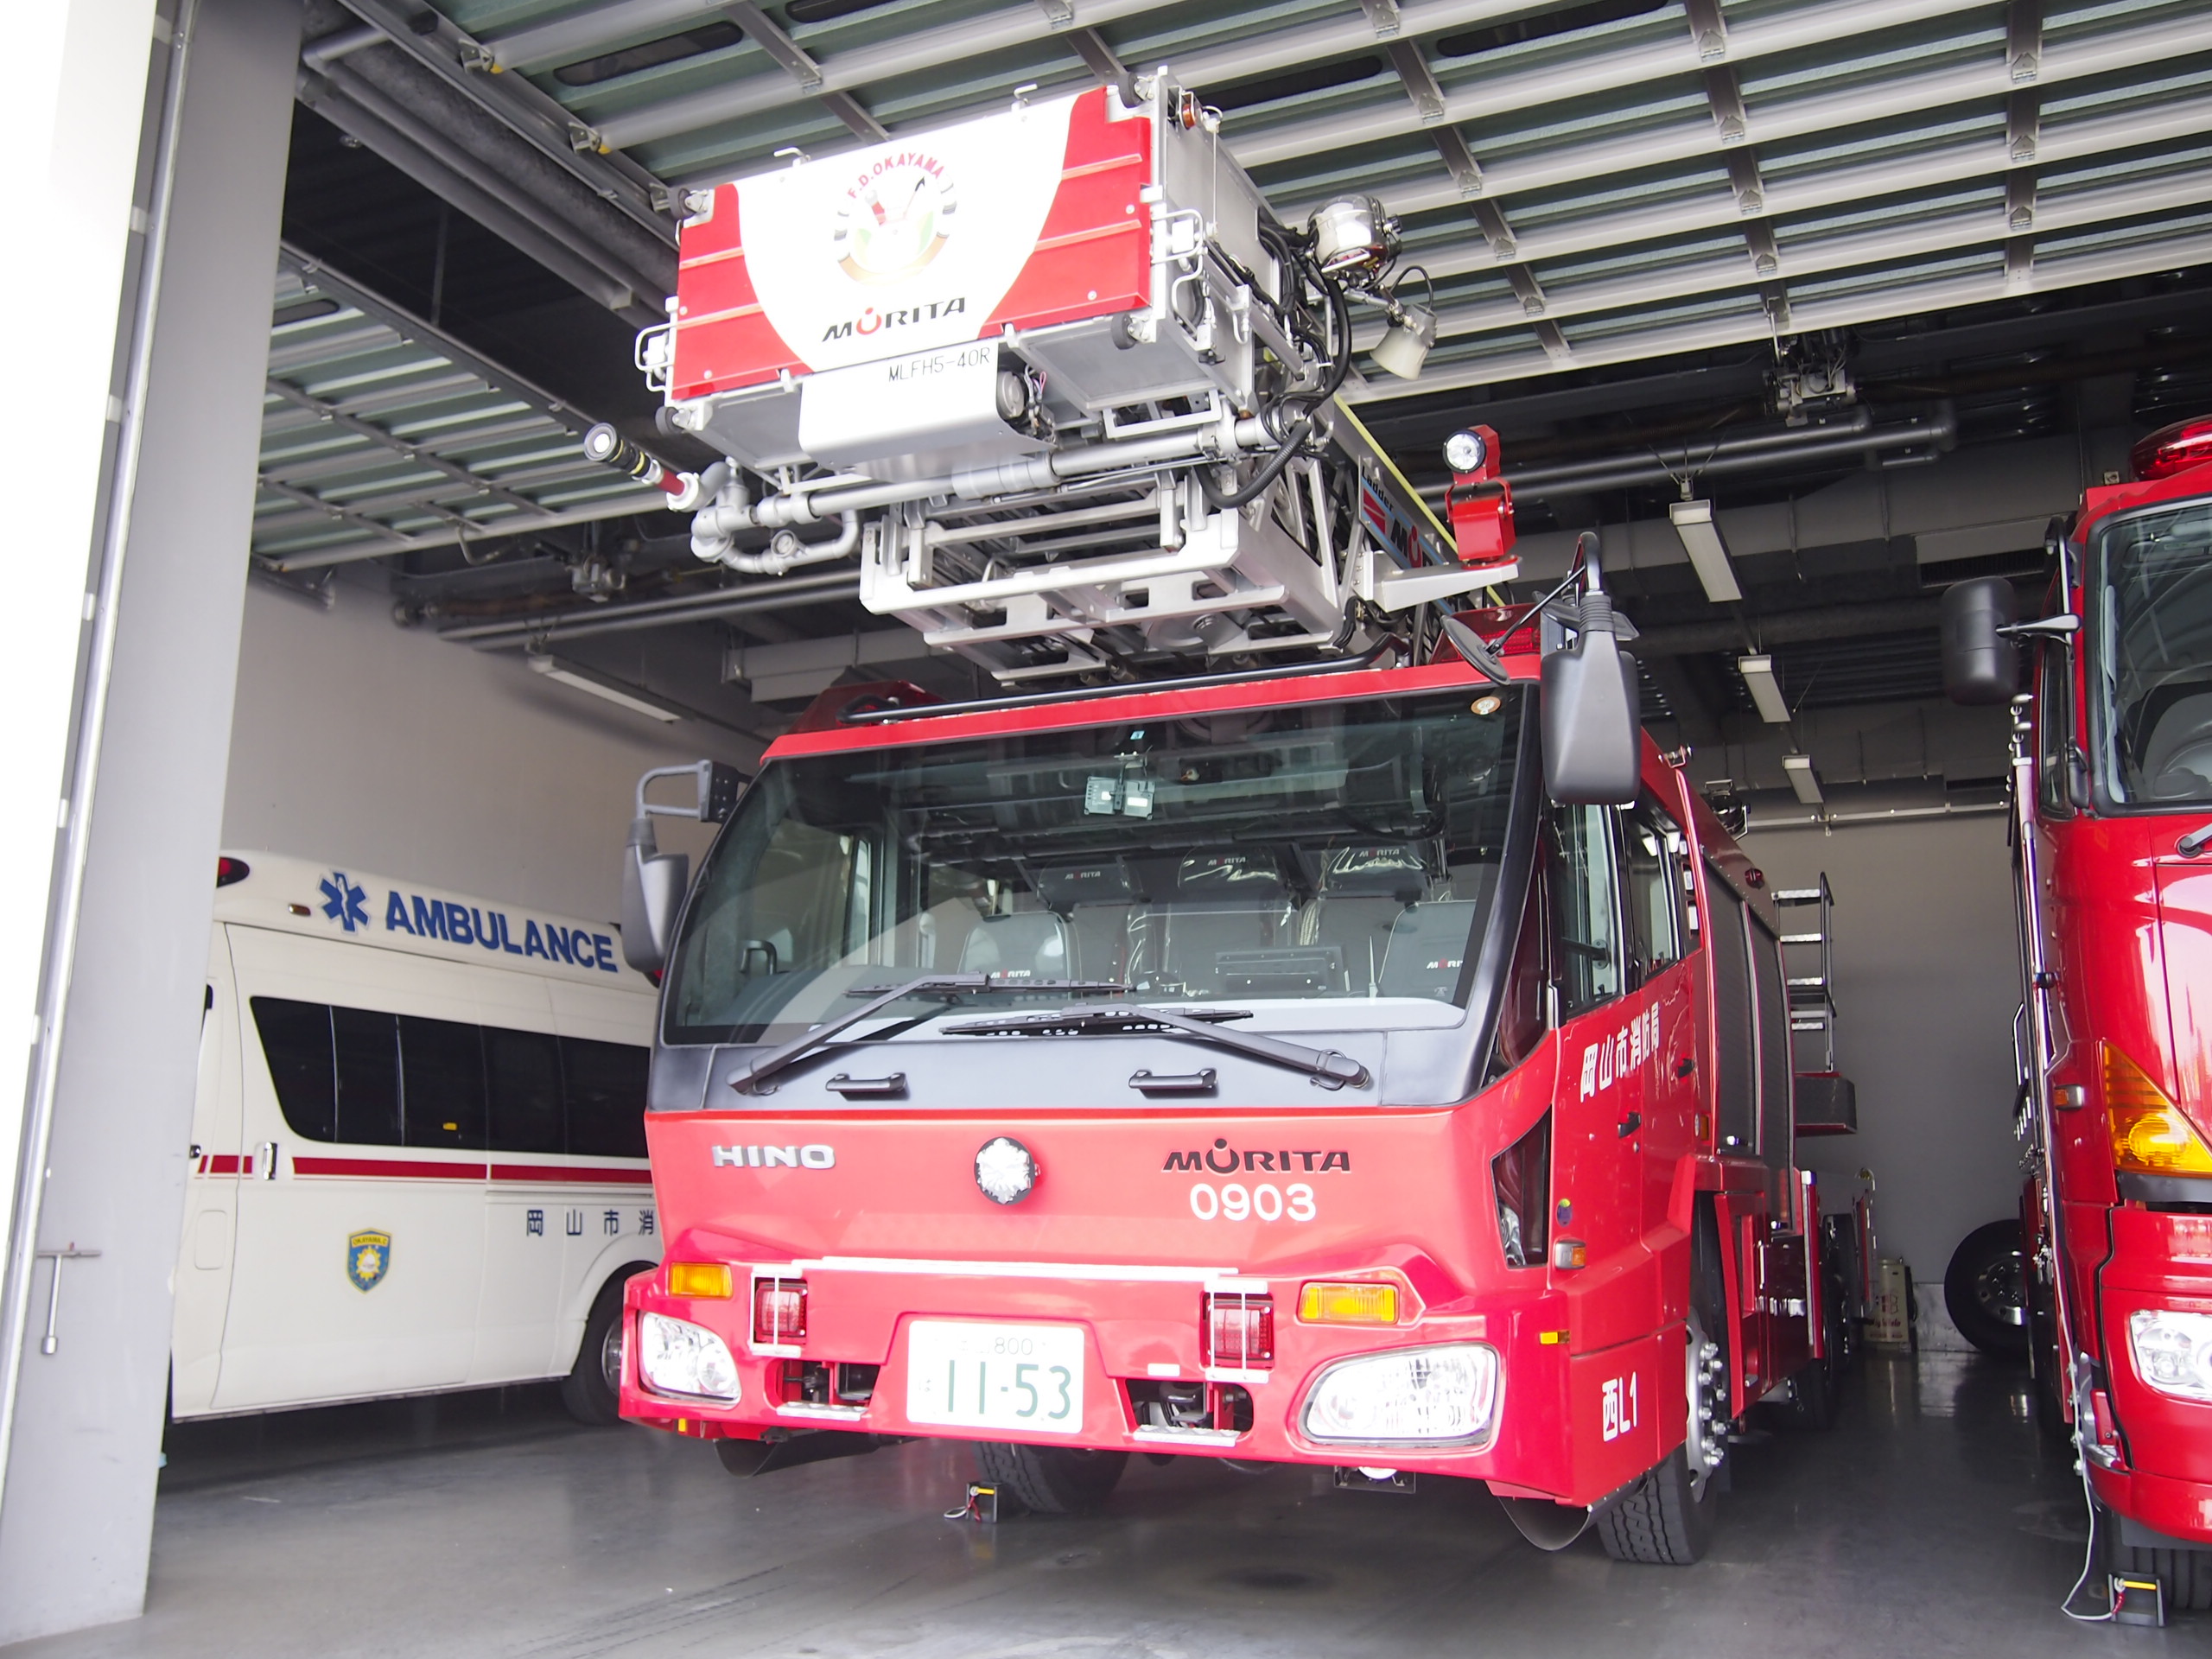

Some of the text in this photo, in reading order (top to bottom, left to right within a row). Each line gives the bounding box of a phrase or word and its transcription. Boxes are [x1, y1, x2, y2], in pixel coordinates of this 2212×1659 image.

[822, 297, 965, 342] MORITA
[888, 346, 991, 382] MLFH5-40R
[1362, 466, 1394, 512] Ladder
[385, 890, 618, 973] AMBULANCE
[1580, 1001, 1659, 1103] 岡山市消防局
[712, 1144, 836, 1169] HINO
[1162, 1138, 1351, 1175] MORITA
[1190, 1183, 1316, 1221] 0903
[995, 1337, 1033, 1356] 800
[948, 1359, 1071, 1420] 11-53
